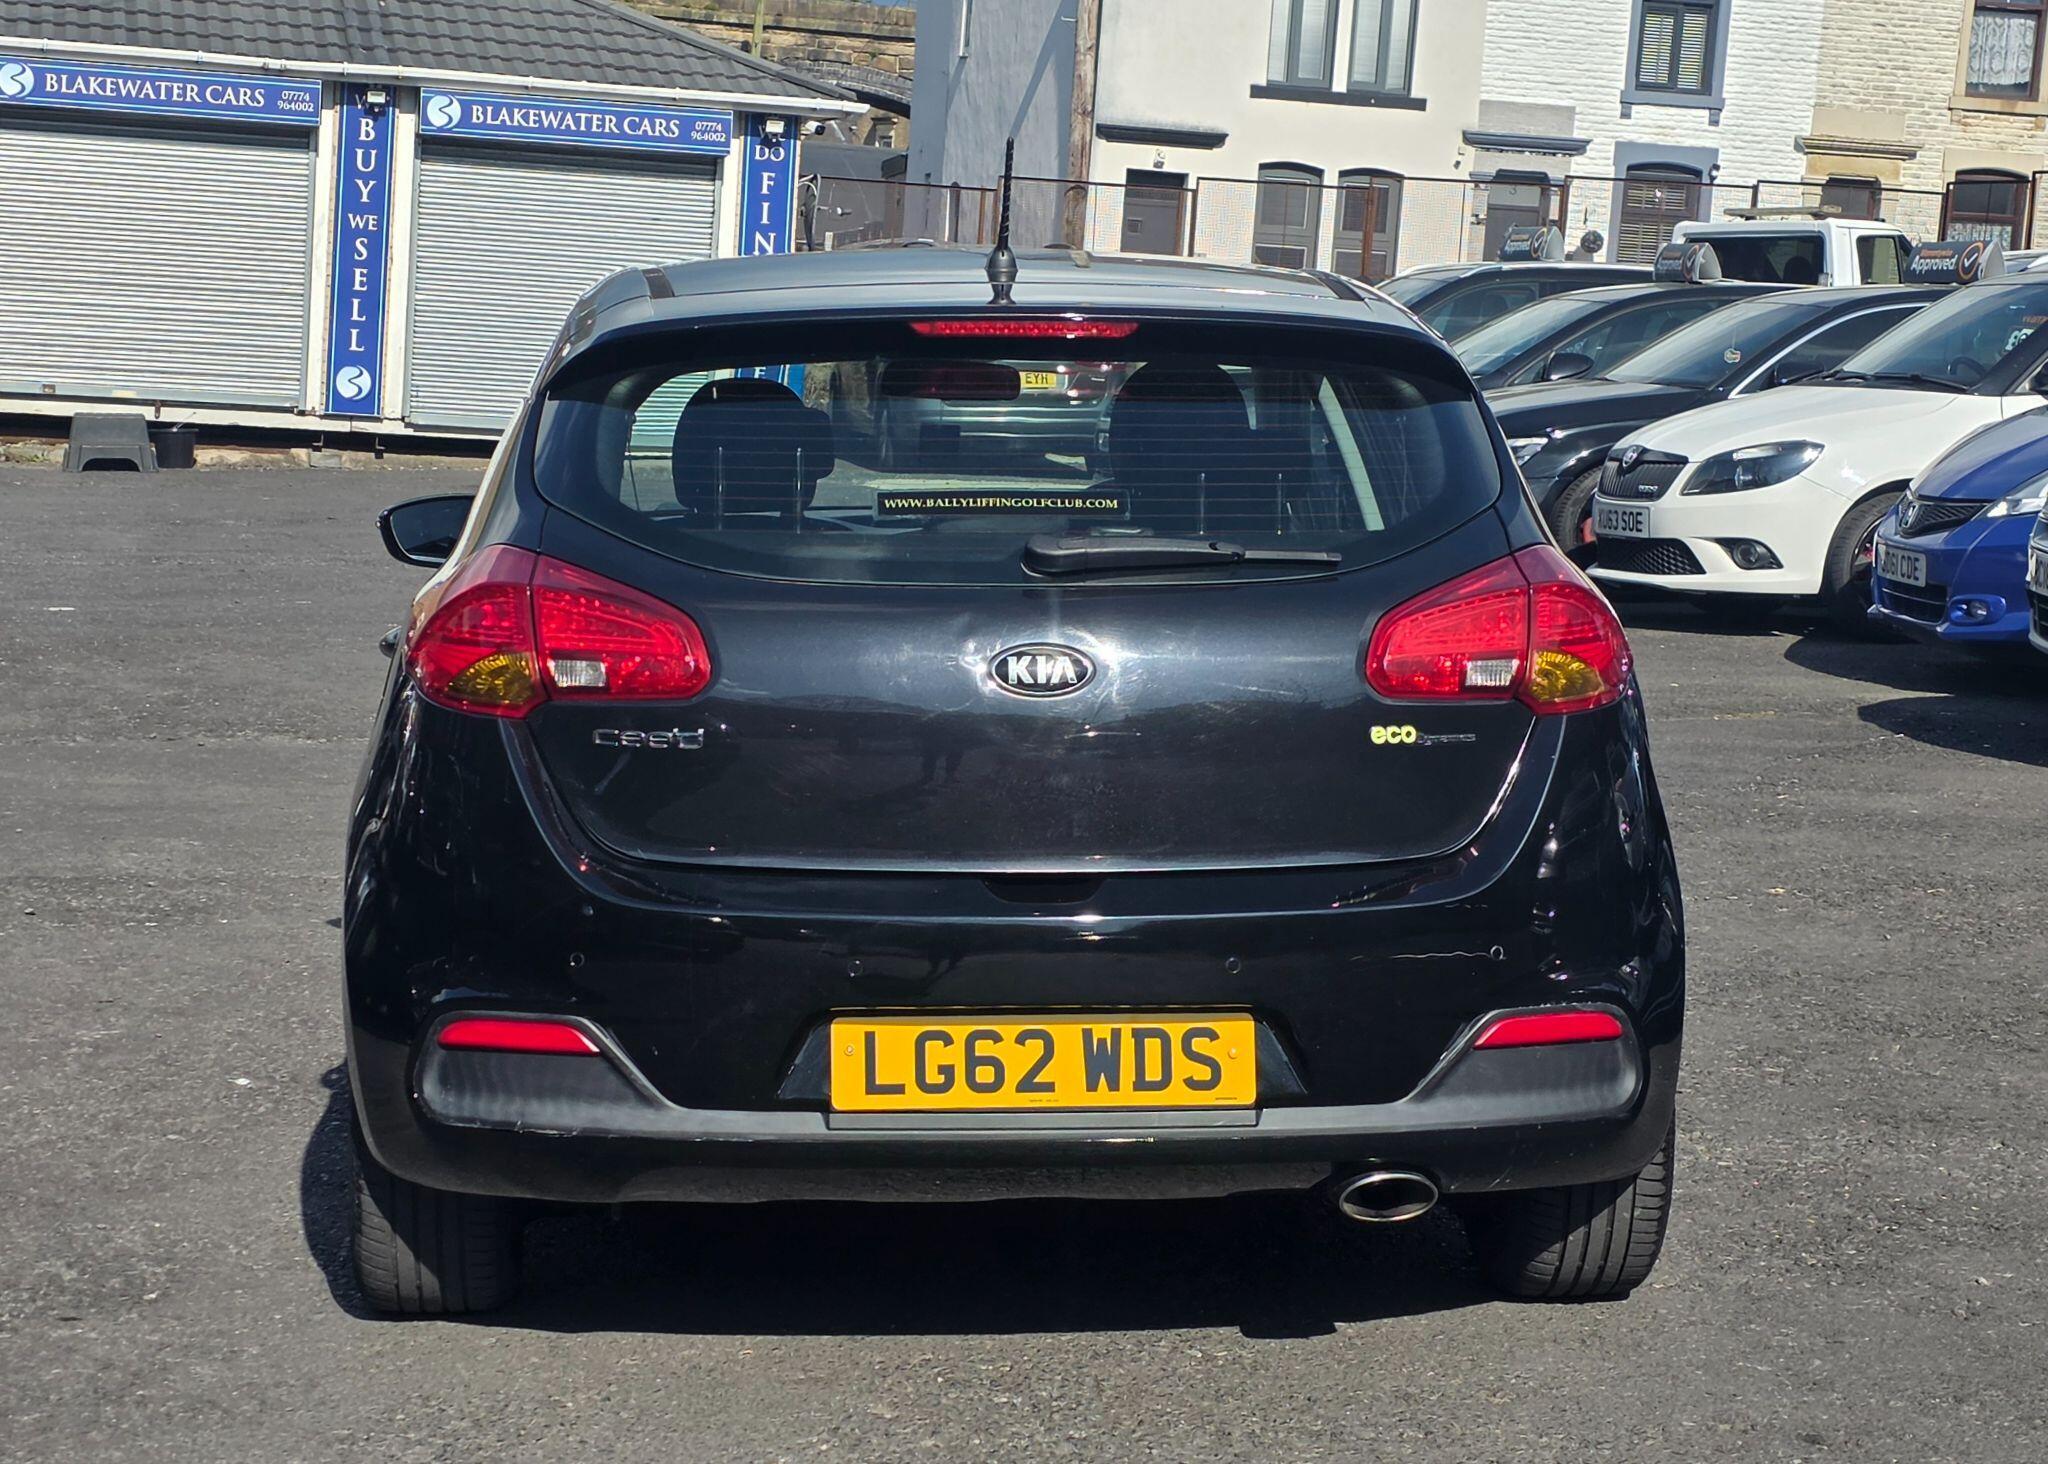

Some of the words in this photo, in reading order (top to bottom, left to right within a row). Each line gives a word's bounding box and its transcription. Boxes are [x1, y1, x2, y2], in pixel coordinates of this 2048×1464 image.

[45, 73, 202, 103] BLAKEWATER
[205, 85, 265, 107] CARS
[281, 90, 310, 101] 07774
[277, 100, 314, 112] 964002
[471, 105, 619, 135] BLAKEWATER
[623, 116, 680, 138] CARS
[695, 121, 722, 131] 07774
[754, 144, 785, 162] DO
[348, 213, 378, 231] WE
[1911, 254, 1958, 275] Approved
[884, 497, 1118, 509] WWW.BALLYLIFFINGOLFCLUB.COM
[1621, 510, 1643, 533] SOE
[1900, 554, 1920, 582] CDE
[1006, 655, 1078, 685] KIA
[864, 1029, 1056, 1095] LG62
[1082, 1026, 1222, 1092] WDS
